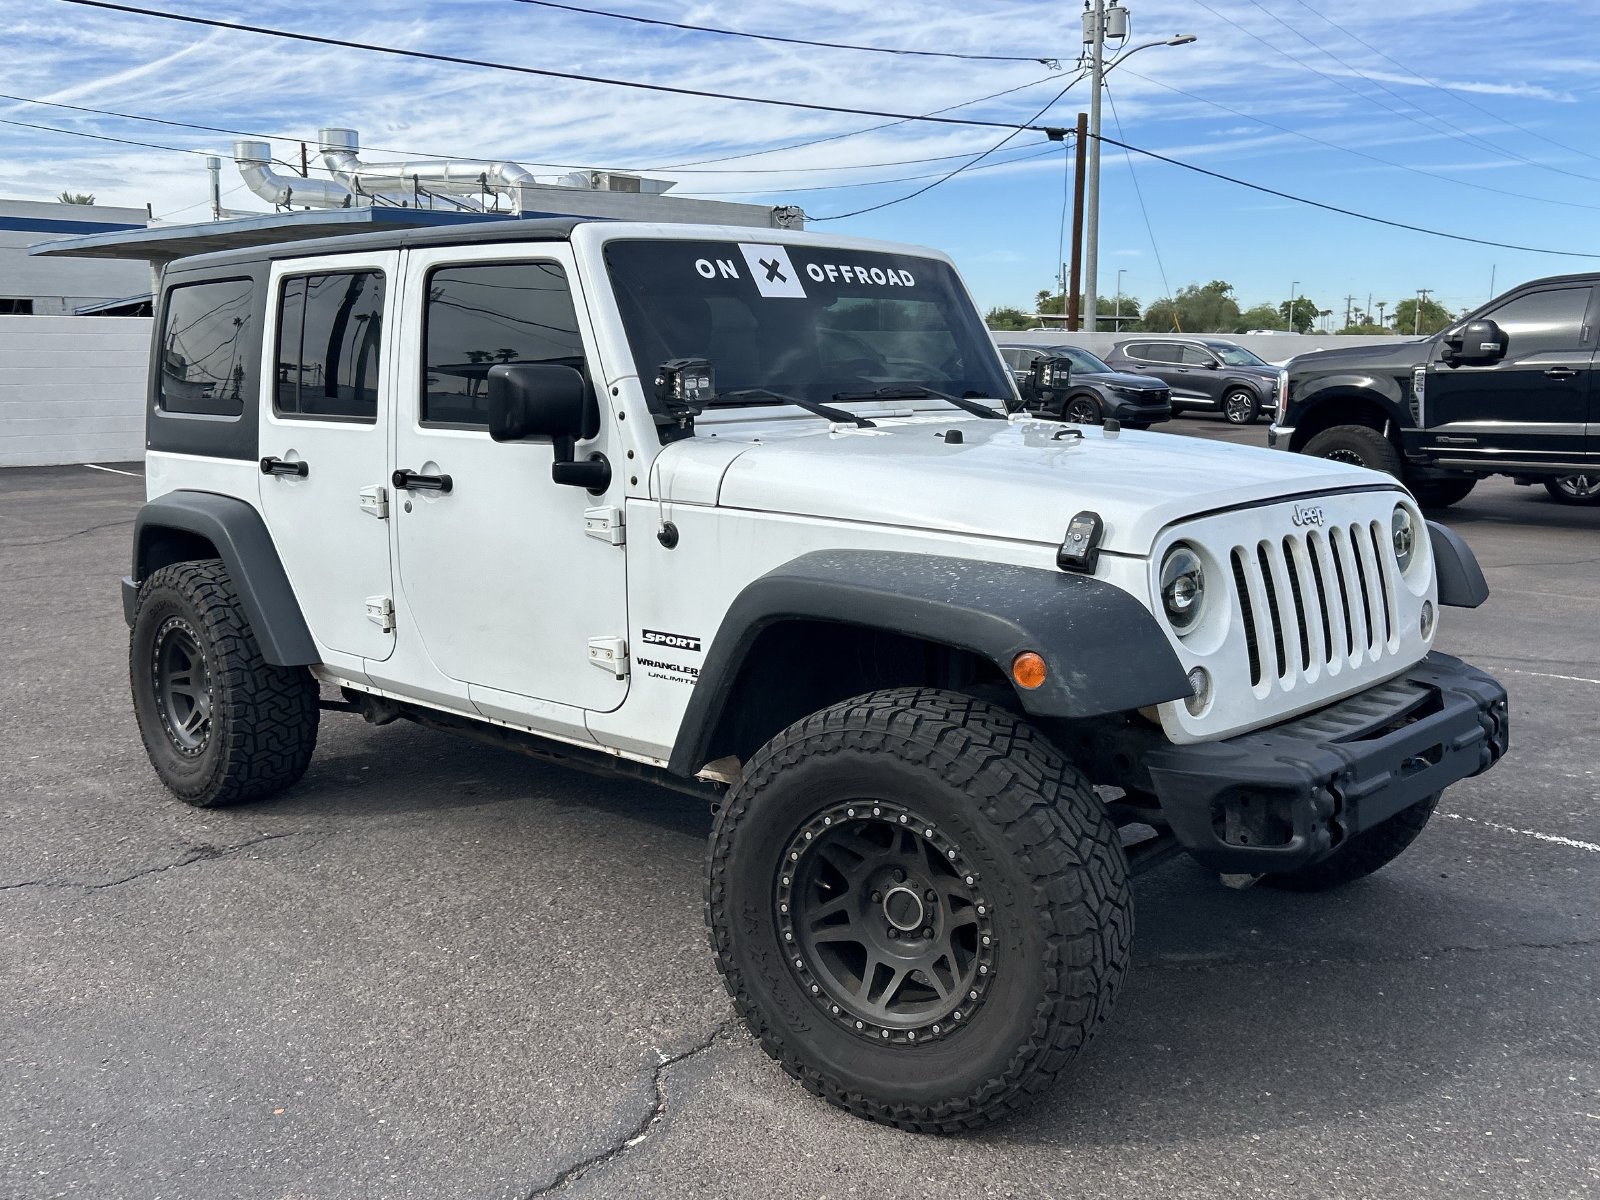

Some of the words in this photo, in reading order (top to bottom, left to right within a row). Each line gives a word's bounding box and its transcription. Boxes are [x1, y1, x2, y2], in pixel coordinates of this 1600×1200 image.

[695, 258, 740, 279] ON
[806, 263, 915, 287] OFFROAD
[1292, 504, 1324, 527] Jeep
[643, 632, 701, 649] SPORT
[636, 657, 699, 676] WRANGLER
[648, 671, 697, 685] UNLIMITE
